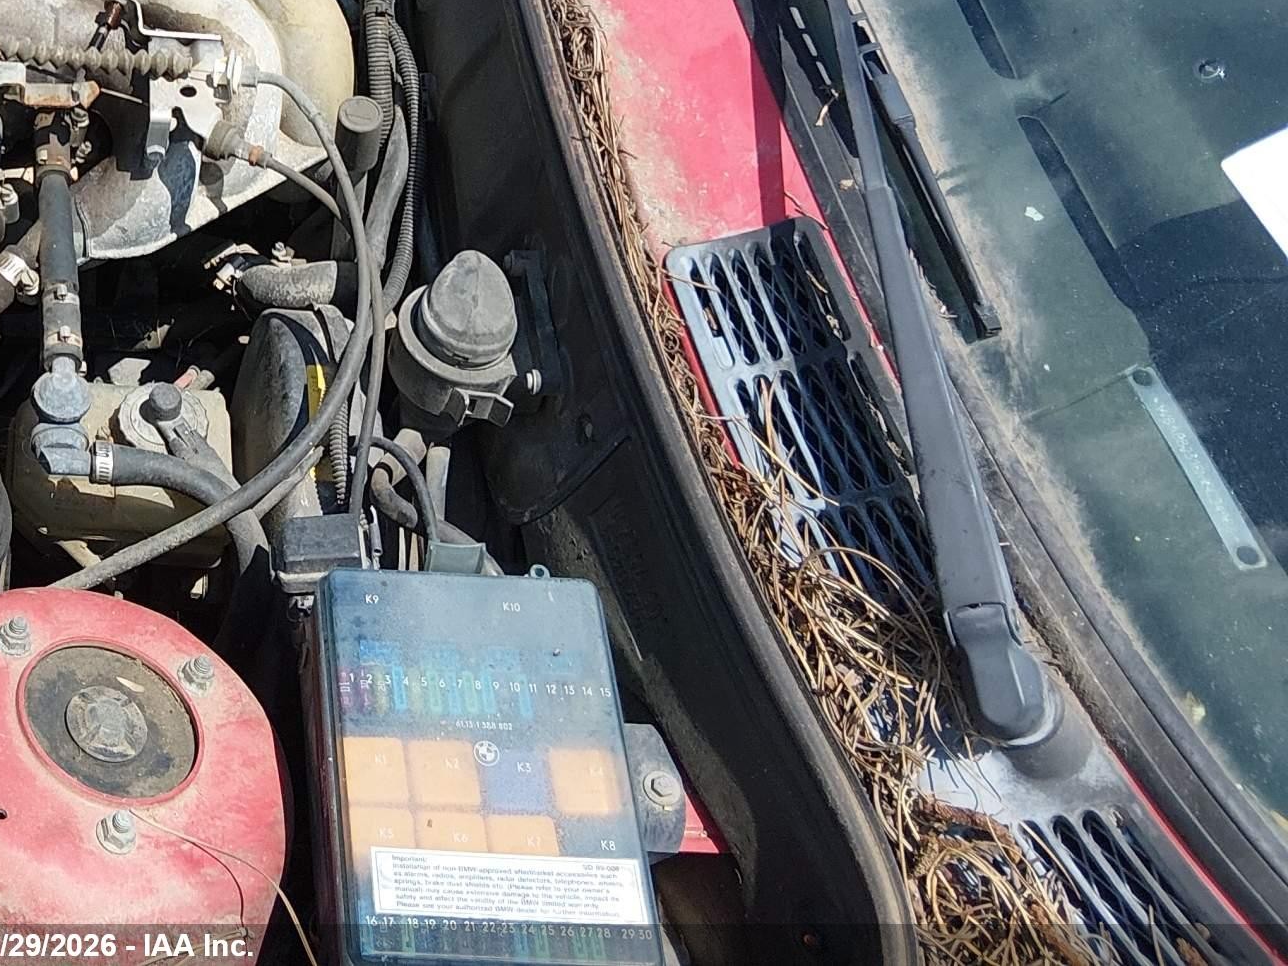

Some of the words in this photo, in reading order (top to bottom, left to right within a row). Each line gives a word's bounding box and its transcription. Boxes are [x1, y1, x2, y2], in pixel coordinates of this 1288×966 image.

[365, 593, 379, 604] K9
[502, 601, 521, 612] K10
[349, 673, 354, 682] 1
[366, 674, 373, 684] 2
[385, 675, 391, 684] 3
[403, 676, 409, 686] 4
[421, 677, 427, 687] 5
[439, 678, 446, 688] 6
[457, 679, 463, 689] 7
[474, 681, 482, 690] 8
[492, 681, 500, 690] 9
[509, 682, 521, 692] 10
[529, 684, 537, 693] 11
[546, 684, 556, 695] 12
[564, 685, 575, 696] 13
[582, 686, 593, 696] 14
[600, 687, 611, 698] 15
[516, 761, 532, 773] K3
[600, 840, 616, 851] K8
[365, 915, 378, 927] 16
[383, 916, 394, 927] 17
[407, 918, 419, 929] 18
[424, 918, 436, 930] 19
[442, 920, 457, 931] 20
[464, 921, 476, 932] 21
[482, 921, 496, 933] 22
[502, 924, 516, 934] 23
[521, 925, 536, 935] 24
[541, 925, 555, 936] 25
[560, 926, 575, 937] 26
[580, 927, 593, 938] 27
[597, 927, 611, 939] 28
[621, 928, 635, 939] 29
[638, 929, 653, 940] 30
